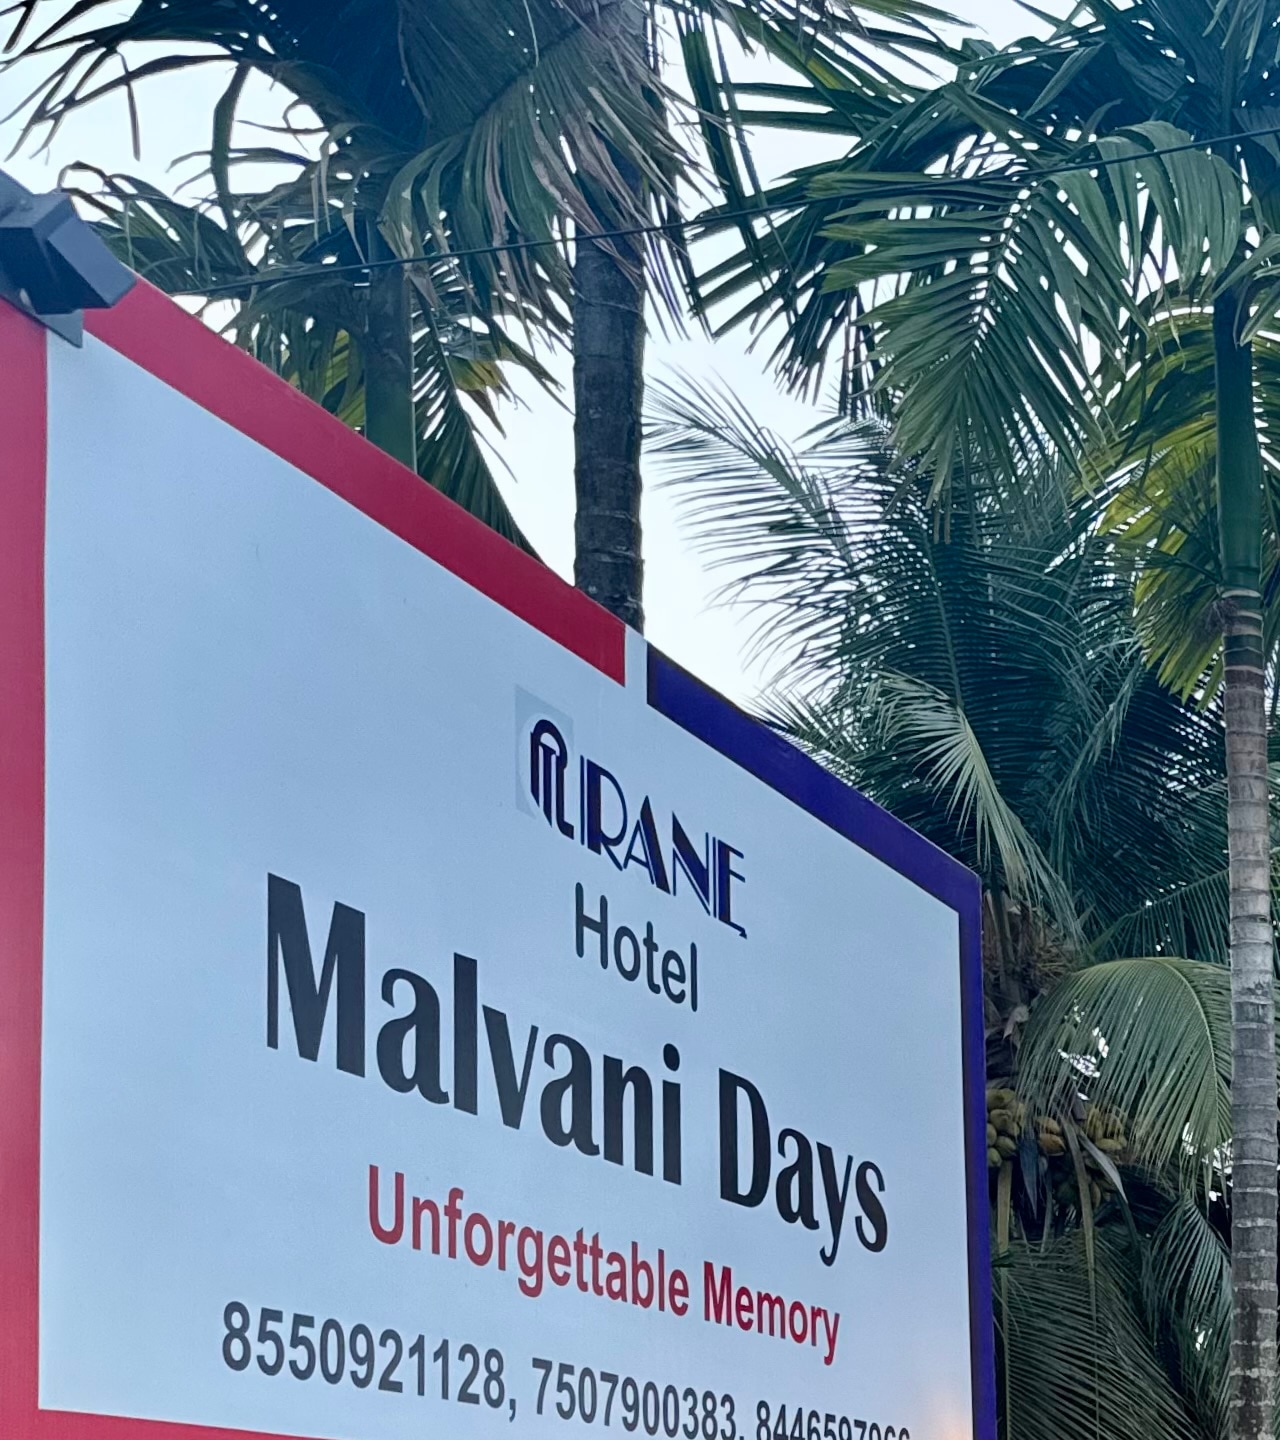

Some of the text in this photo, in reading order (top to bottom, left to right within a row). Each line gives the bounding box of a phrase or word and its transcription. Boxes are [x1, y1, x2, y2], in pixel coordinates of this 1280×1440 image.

[579, 753, 748, 941] RANE
[574, 881, 699, 1014] Hotel
[266, 871, 889, 1268] Malvani Days
[368, 1162, 842, 1367] Unforgettable Memory
[221, 1299, 518, 1424] 8550921128,
